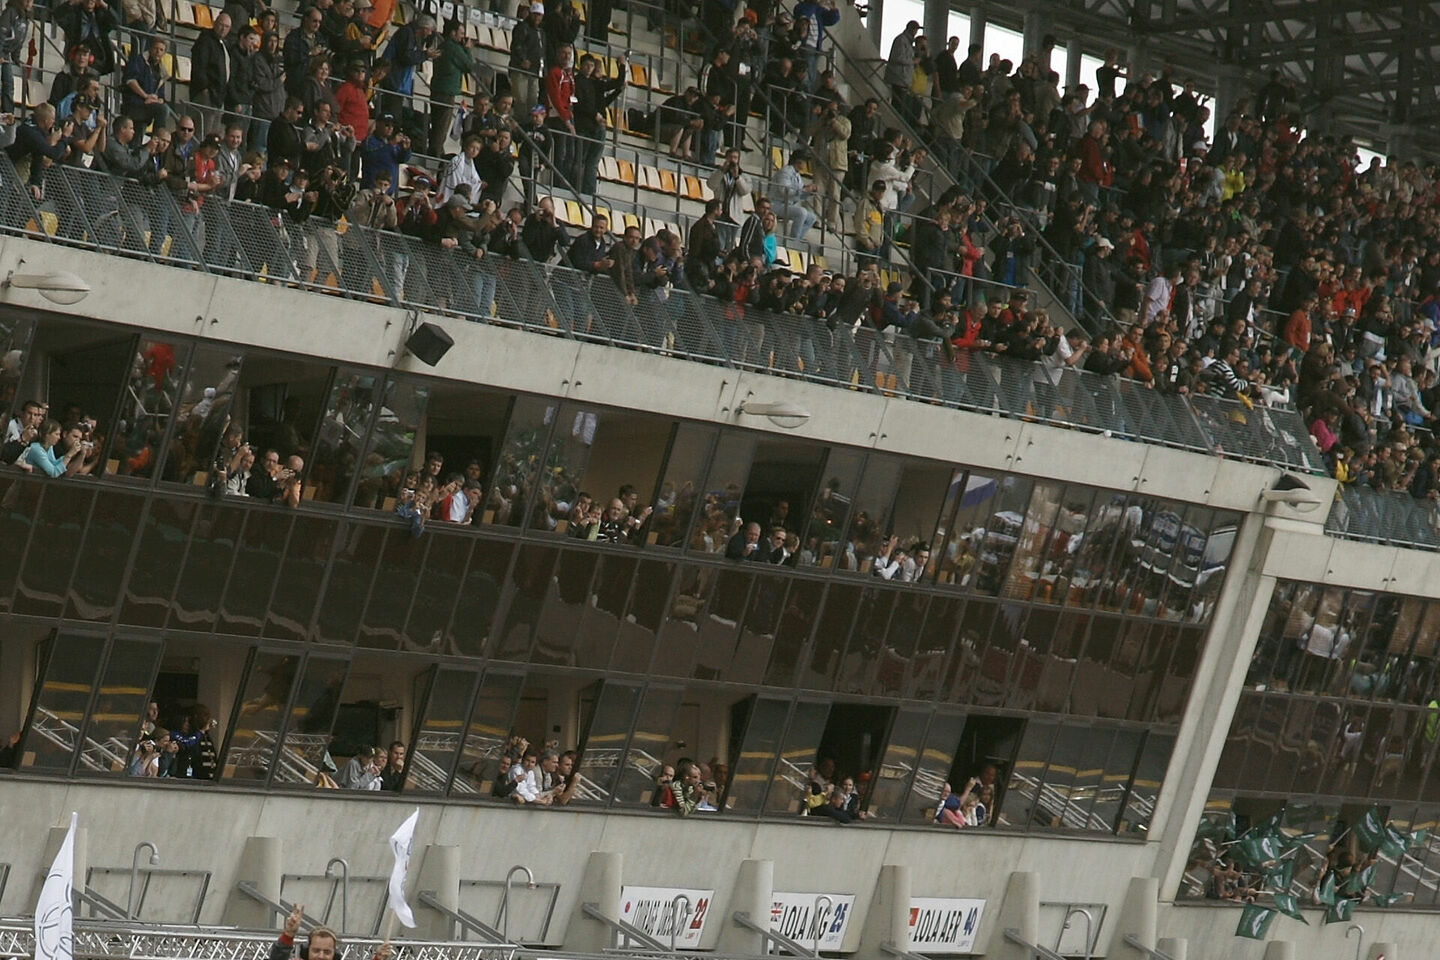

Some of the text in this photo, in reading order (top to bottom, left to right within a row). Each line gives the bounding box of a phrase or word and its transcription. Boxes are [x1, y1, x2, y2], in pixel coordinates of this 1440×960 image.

[689, 898, 709, 929] 22
[829, 903, 849, 933] 25
[913, 910, 943, 942] LOLA
[938, 910, 962, 943] AER
